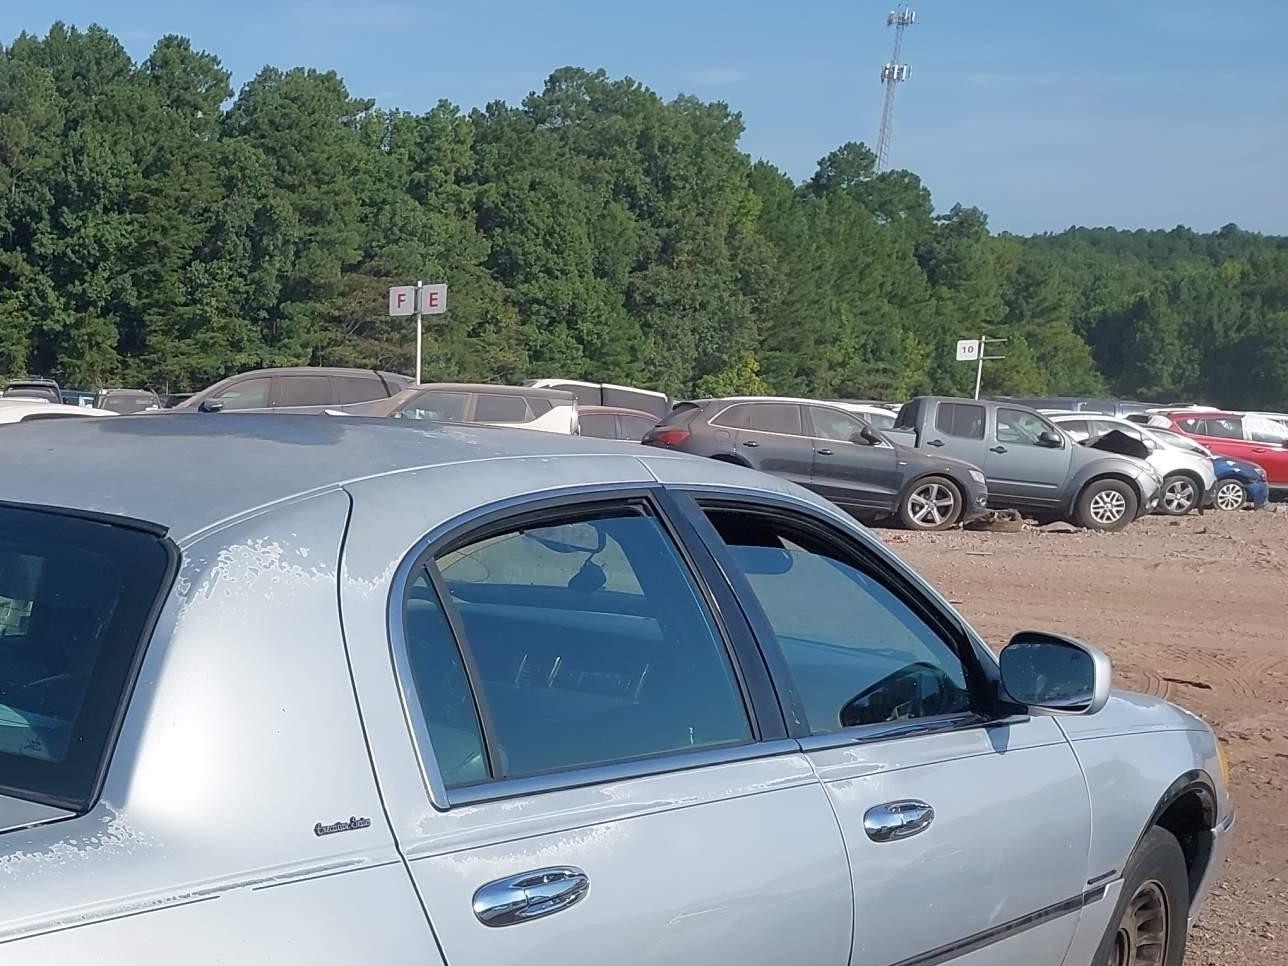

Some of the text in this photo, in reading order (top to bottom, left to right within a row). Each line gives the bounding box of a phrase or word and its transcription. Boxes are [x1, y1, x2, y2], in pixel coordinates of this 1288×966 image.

[397, 293, 406, 309] F
[429, 292, 439, 308] E
[962, 345, 974, 354] 10
